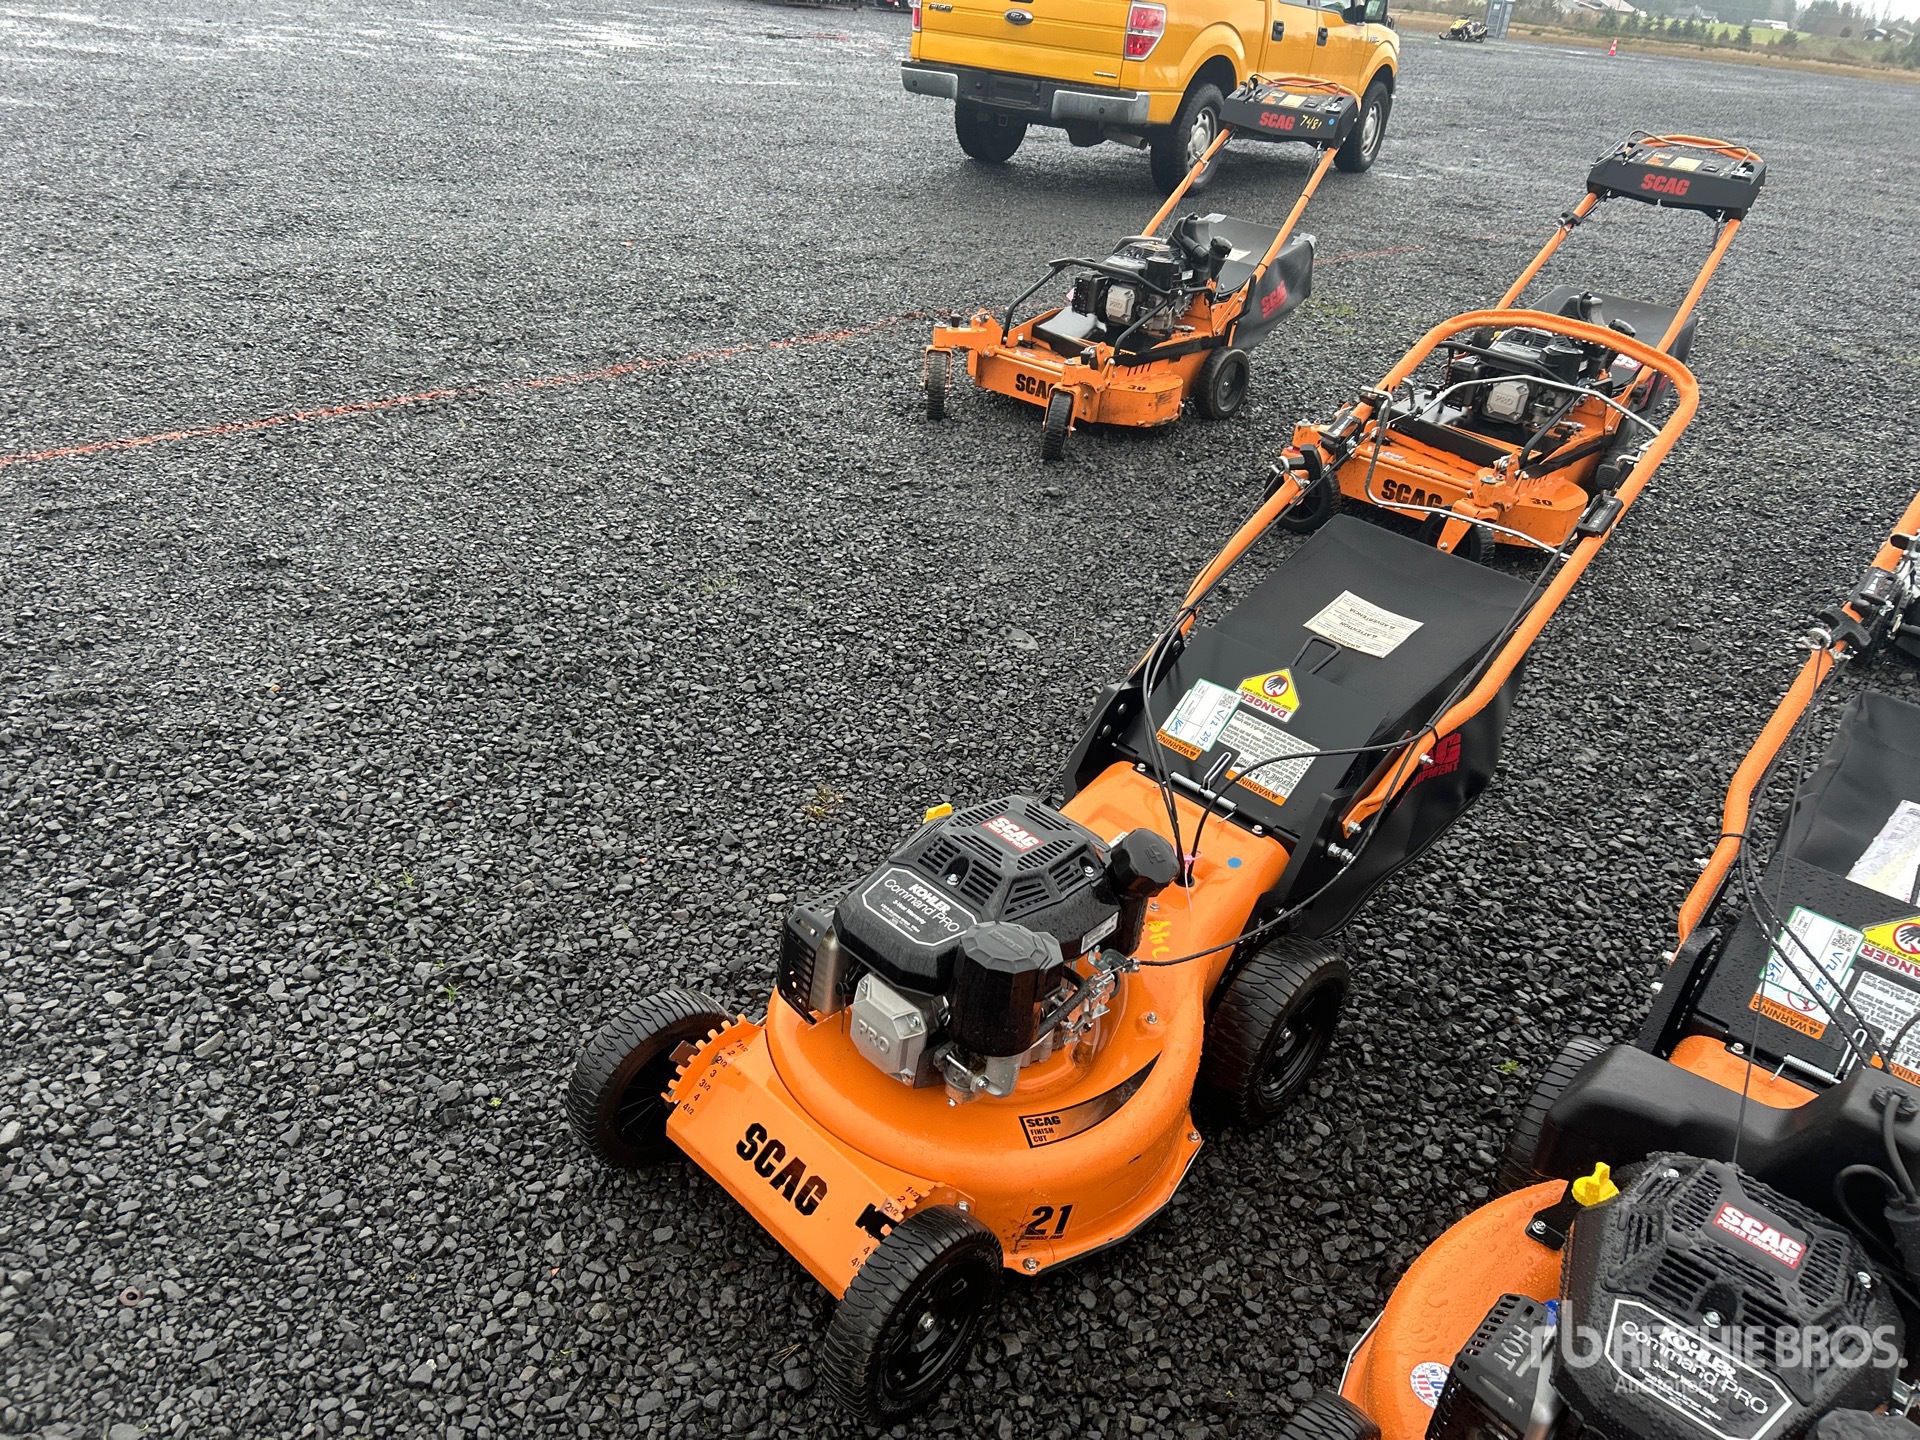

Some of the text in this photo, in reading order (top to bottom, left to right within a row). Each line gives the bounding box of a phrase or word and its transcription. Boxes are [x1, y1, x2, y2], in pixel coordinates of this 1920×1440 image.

[1259, 111, 1296, 131] SCAG
[1640, 173, 1691, 197] SCAG
[1128, 384, 1147, 392] 30
[1494, 393, 1514, 406] PRO
[1380, 478, 1443, 508] SCAG
[1531, 497, 1553, 507] 30
[1338, 621, 1371, 637] ATTENTION
[1239, 690, 1287, 718] DANGER
[1156, 733, 1189, 755] WARNING
[1236, 776, 1272, 797] WARNIN
[989, 816, 1041, 847] SCAG
[883, 877, 936, 915] Command
[931, 911, 962, 932] PRO
[907, 883, 952, 914] KOHLER
[1766, 957, 1783, 981] 165
[1860, 943, 1920, 977] ANGER
[1750, 1000, 1807, 1031] WARNING
[858, 1018, 890, 1055] PRO
[709, 1069, 717, 1078] 3
[693, 1093, 701, 1102] 4
[1026, 1116, 1061, 1128] SCAG
[1030, 1127, 1055, 1136] FINISH
[1033, 1135, 1048, 1143] CUT
[736, 1122, 828, 1216] SCAG
[1025, 1204, 1073, 1236] 21
[1718, 1204, 1803, 1260] SCAG
[1715, 1217, 1795, 1265] POWER EQUIPMENT
[1493, 1324, 1535, 1371] HOT
[1658, 1326, 1738, 1380] KOHLER
[1619, 1318, 1720, 1386] Command
[1718, 1378, 1771, 1415] PRO
